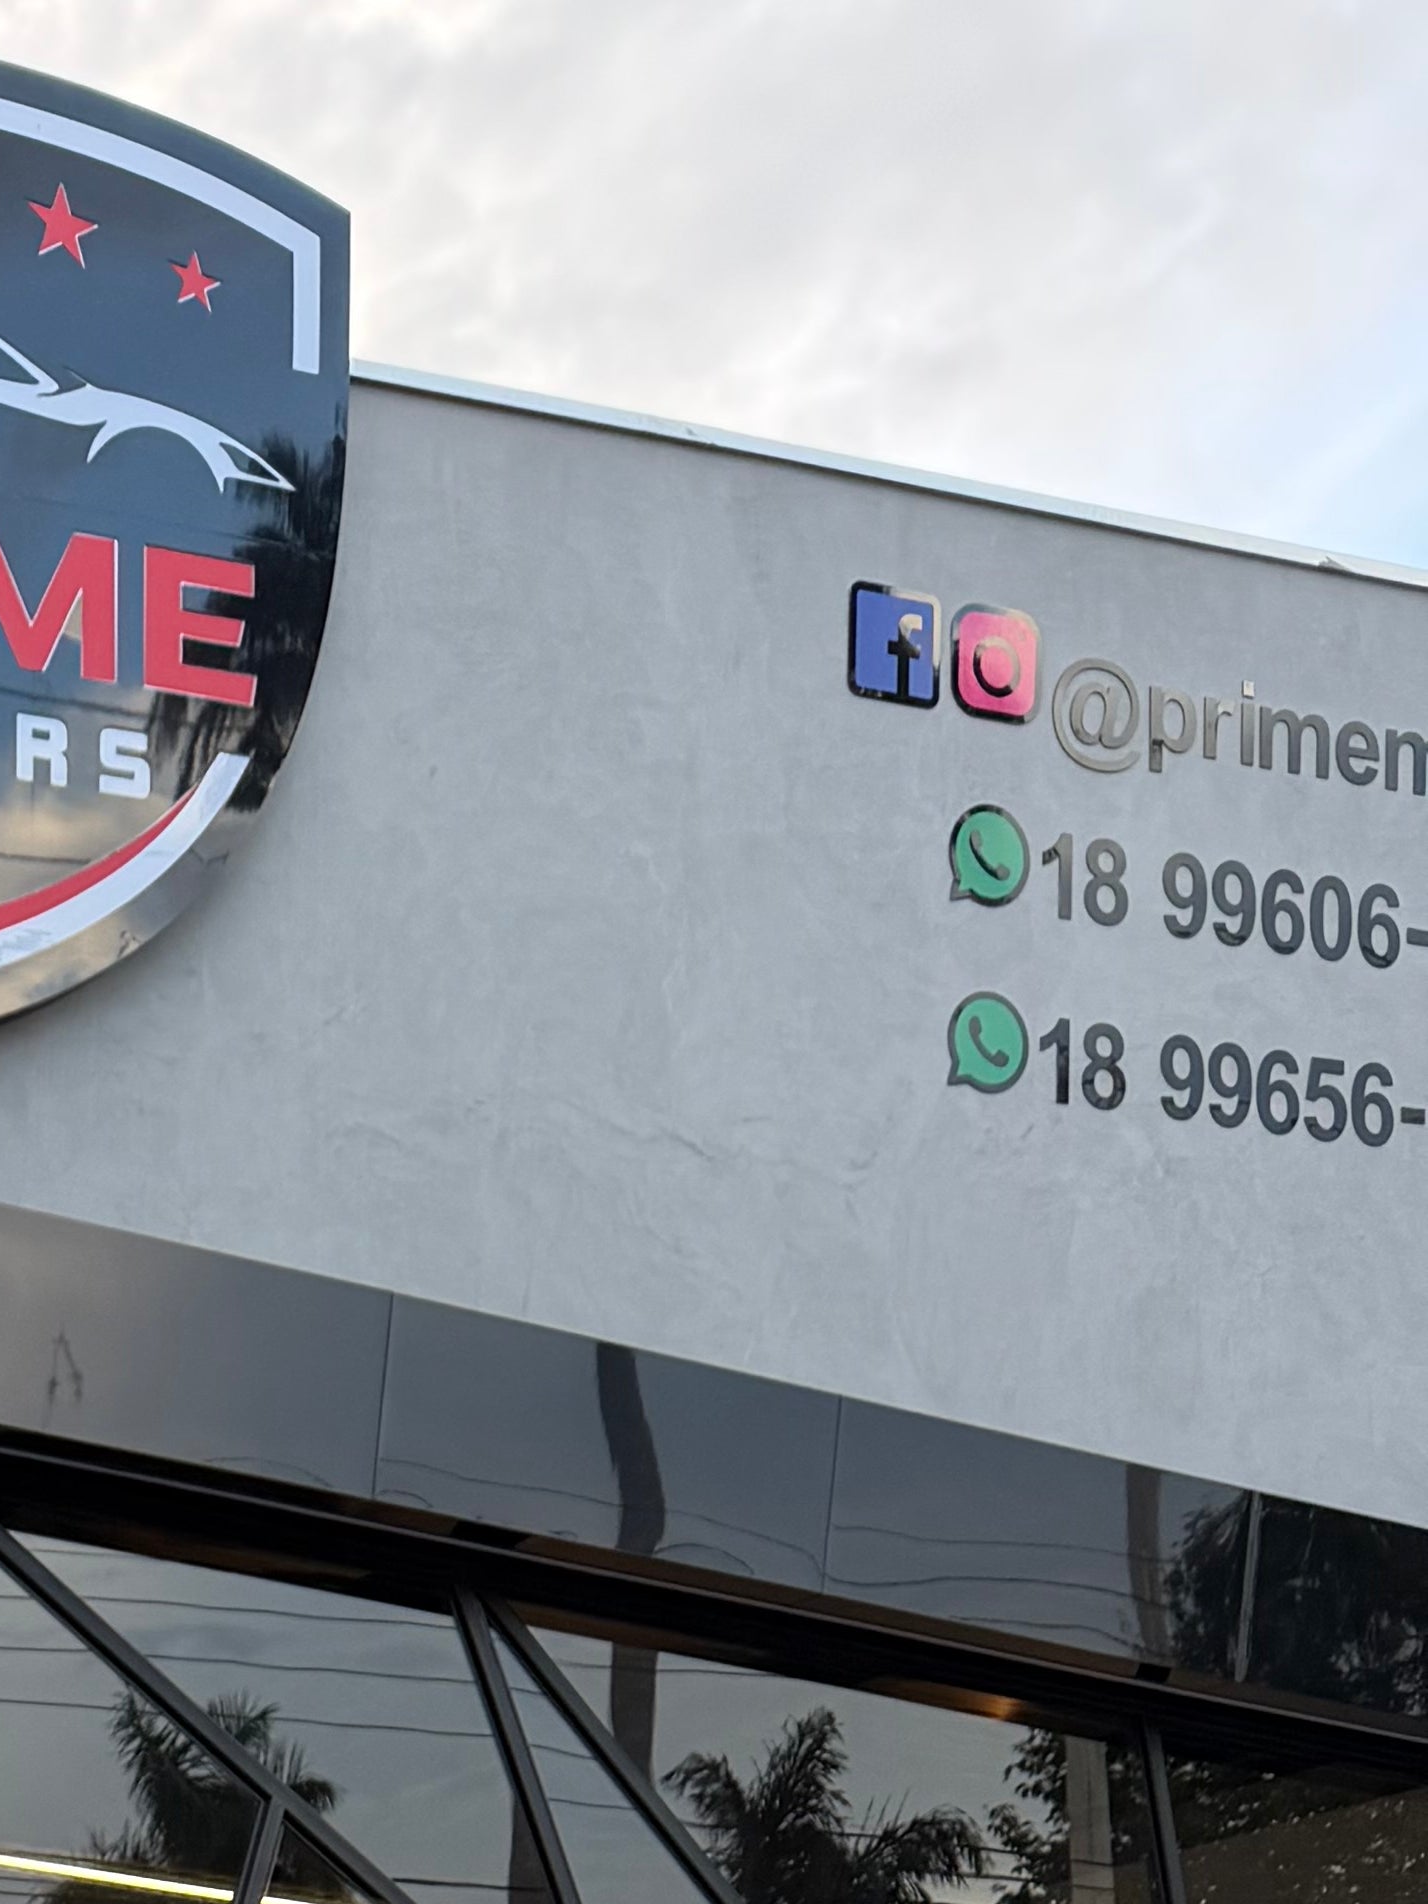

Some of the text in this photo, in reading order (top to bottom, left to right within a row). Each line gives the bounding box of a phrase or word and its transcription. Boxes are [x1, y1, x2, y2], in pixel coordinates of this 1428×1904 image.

[1041, 832, 1130, 927] 18
[1039, 1017, 1426, 1148] 18 99656-
